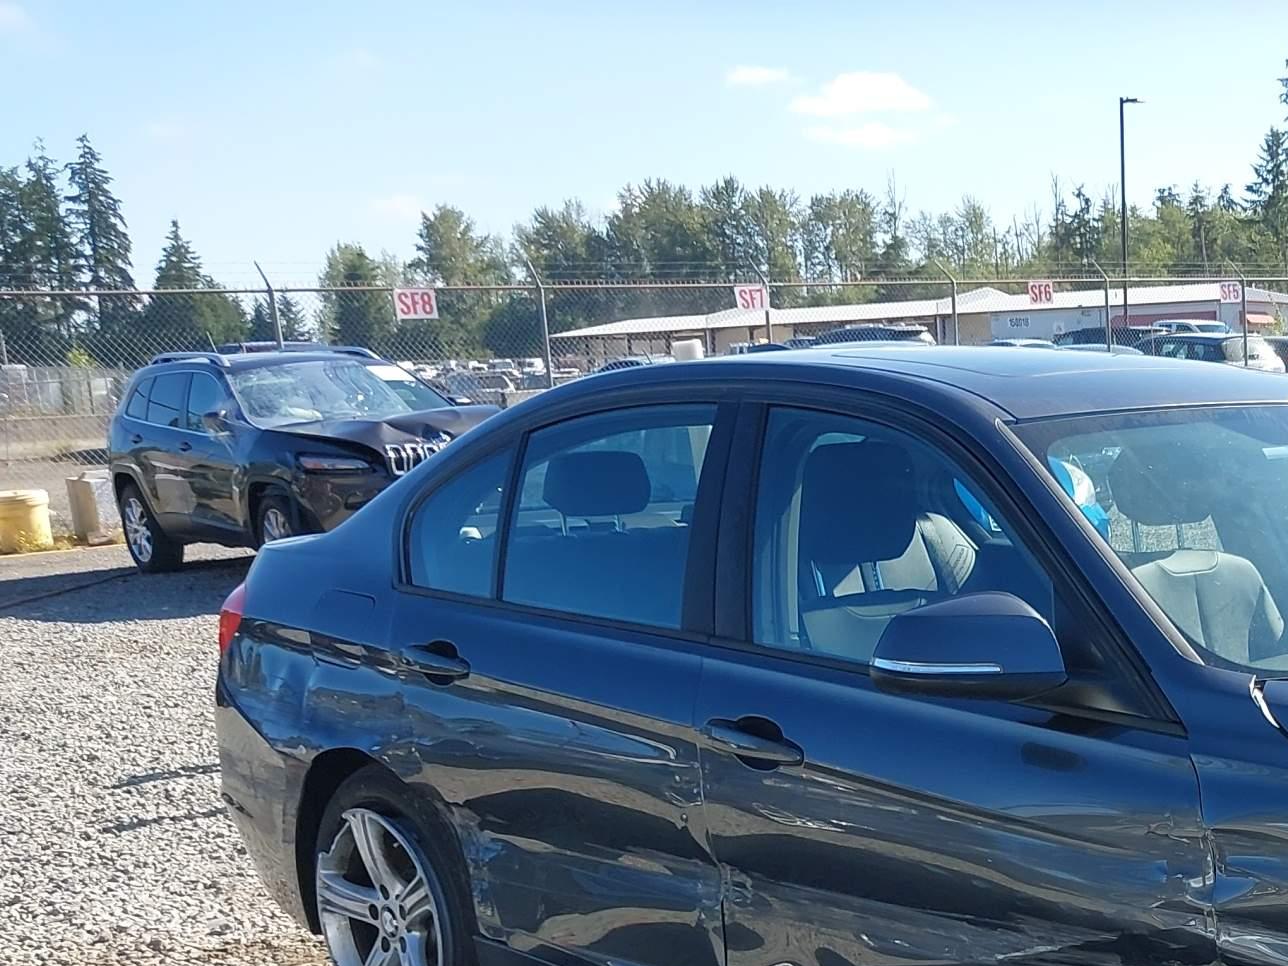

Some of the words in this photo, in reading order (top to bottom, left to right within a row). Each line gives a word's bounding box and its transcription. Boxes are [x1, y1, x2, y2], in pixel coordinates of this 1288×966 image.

[738, 288, 764, 309] SF7
[1030, 283, 1052, 303] SF6
[1220, 283, 1239, 300] SF5
[397, 292, 434, 315] SF8
